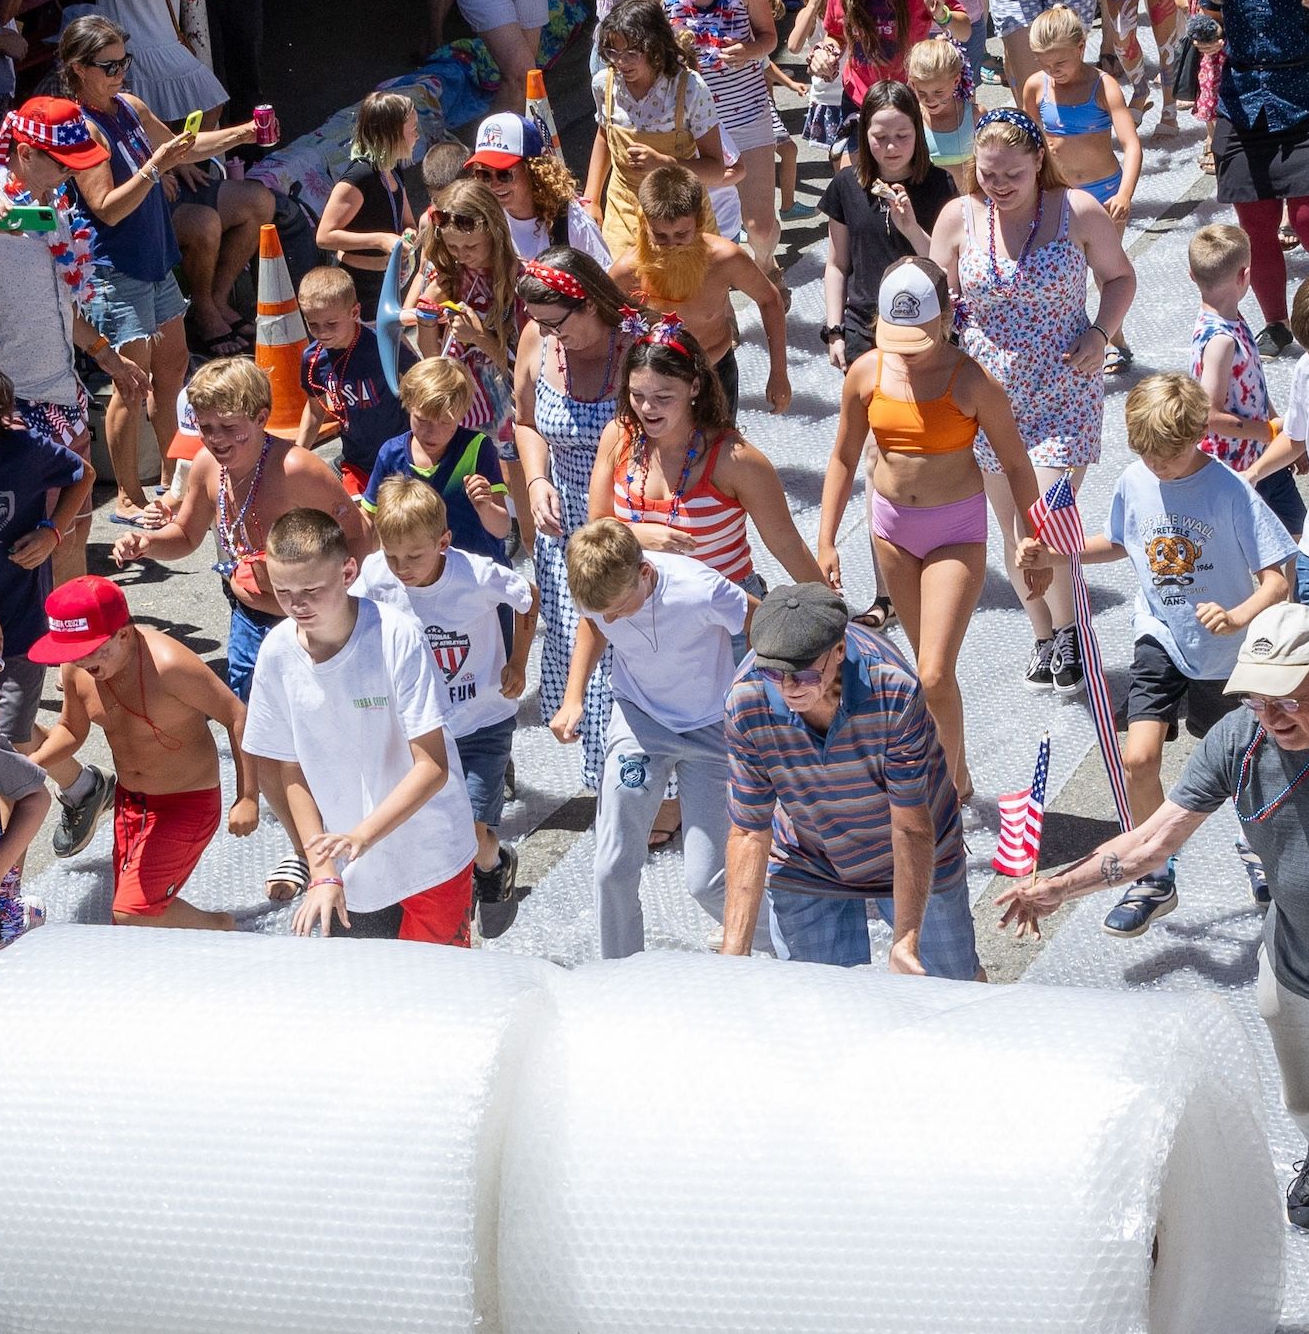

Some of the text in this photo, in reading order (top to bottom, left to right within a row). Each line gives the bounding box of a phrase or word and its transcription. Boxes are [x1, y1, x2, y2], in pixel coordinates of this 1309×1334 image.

[1153, 526, 1191, 538] PRETZELS
[1155, 514, 1179, 526] THE
[1181, 515, 1215, 540] WALL
[1197, 563, 1214, 572] 1966
[1160, 595, 1187, 606] VANS
[448, 682, 477, 705] FUN
